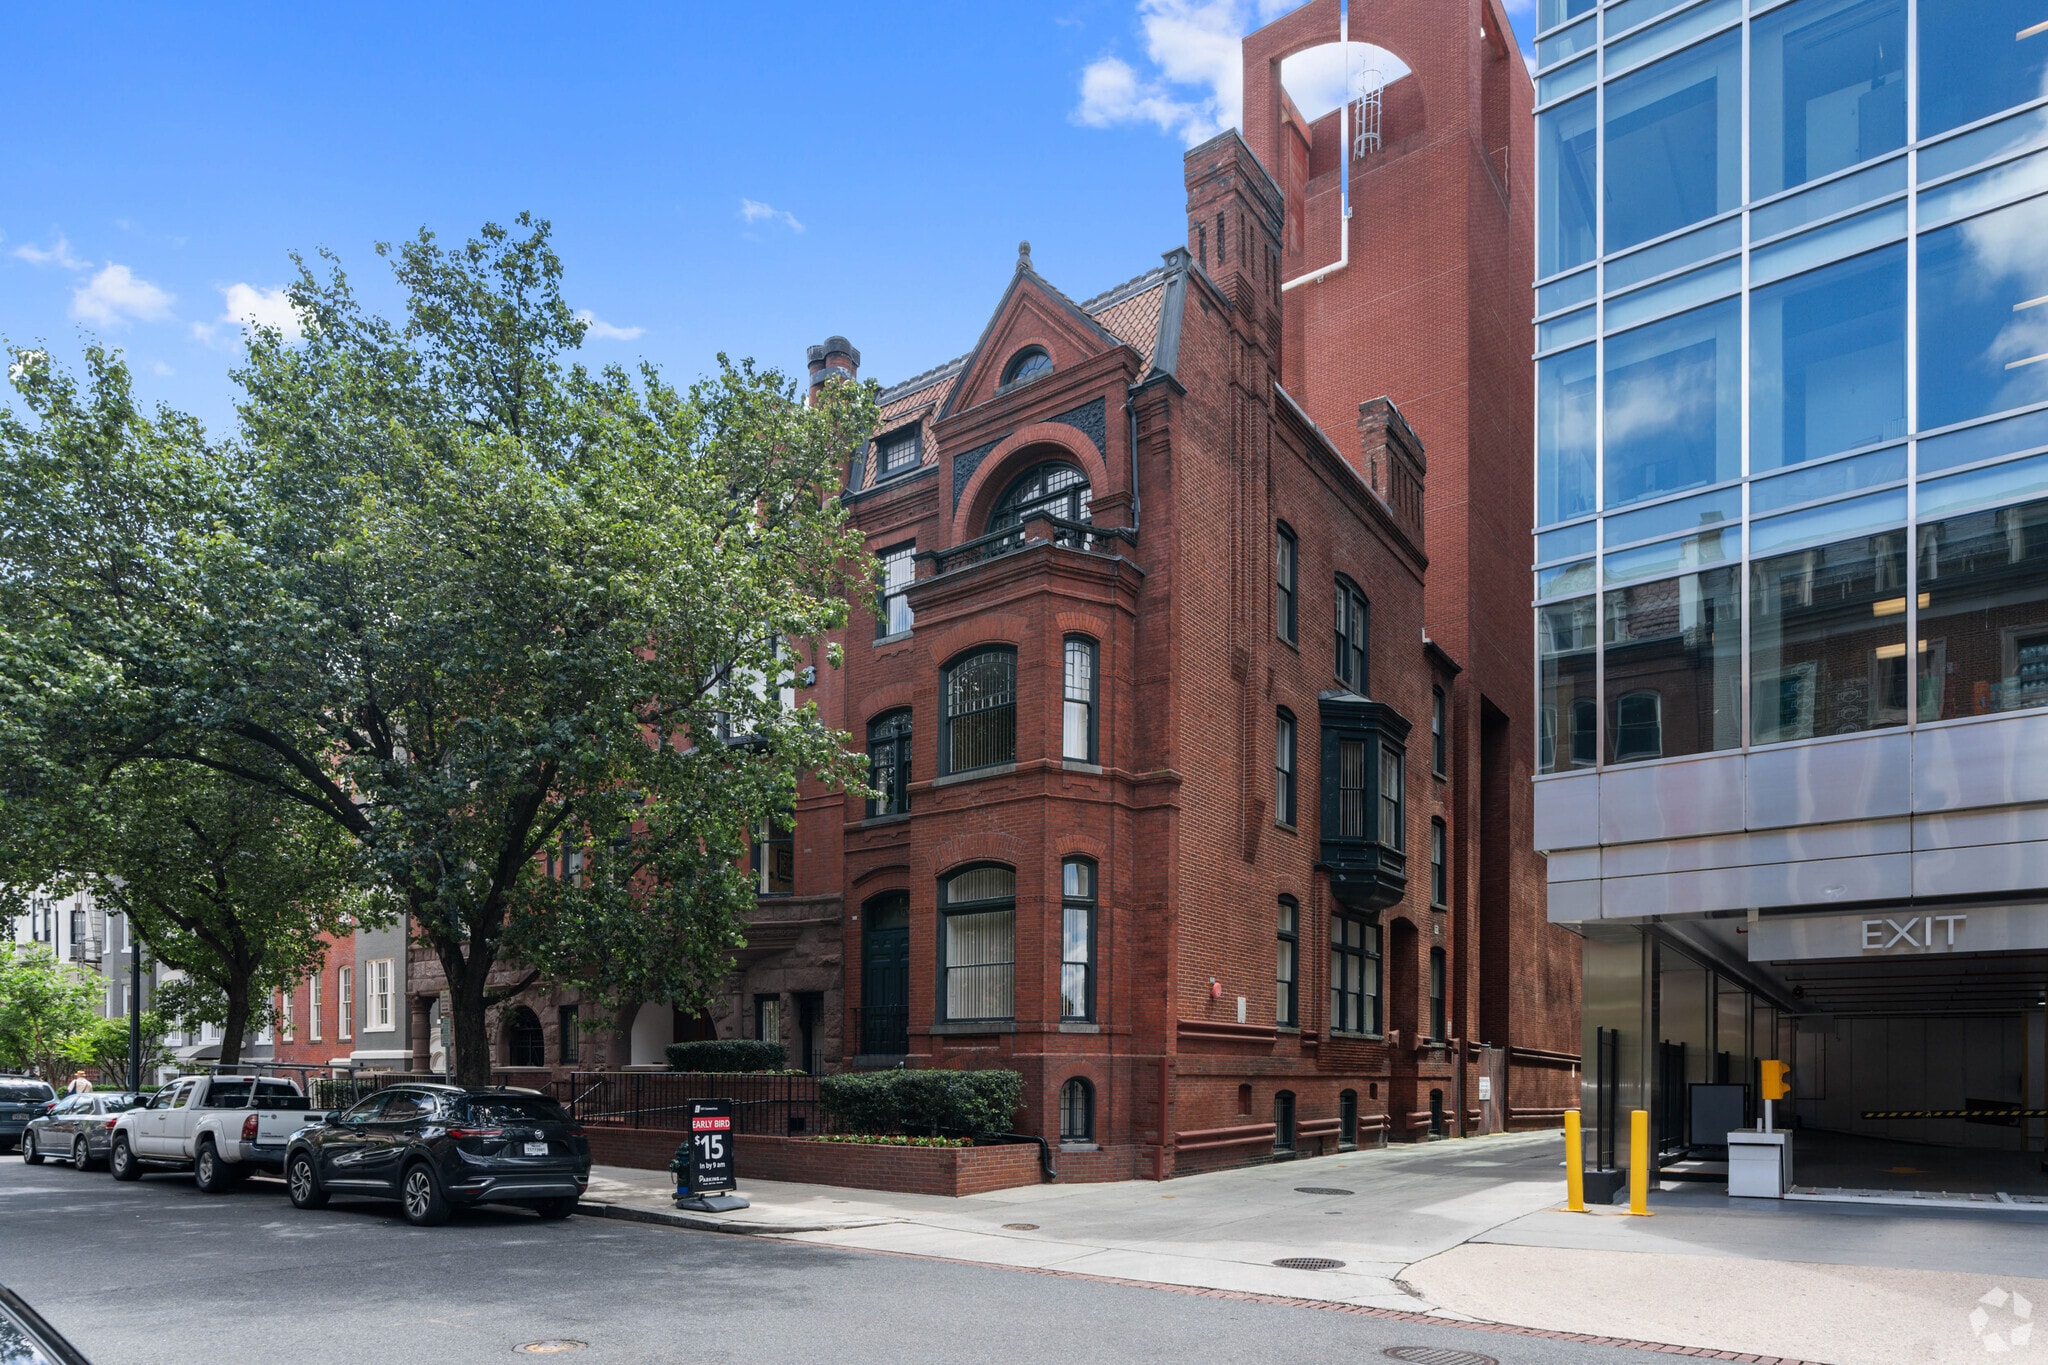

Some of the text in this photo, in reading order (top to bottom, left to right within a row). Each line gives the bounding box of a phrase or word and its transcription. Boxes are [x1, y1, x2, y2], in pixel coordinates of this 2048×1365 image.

[1862, 915, 1967, 949] EXIT
[692, 1119, 731, 1128] EARLY BIRD
[694, 1134, 724, 1160] $15
[706, 1162, 712, 1170] by
